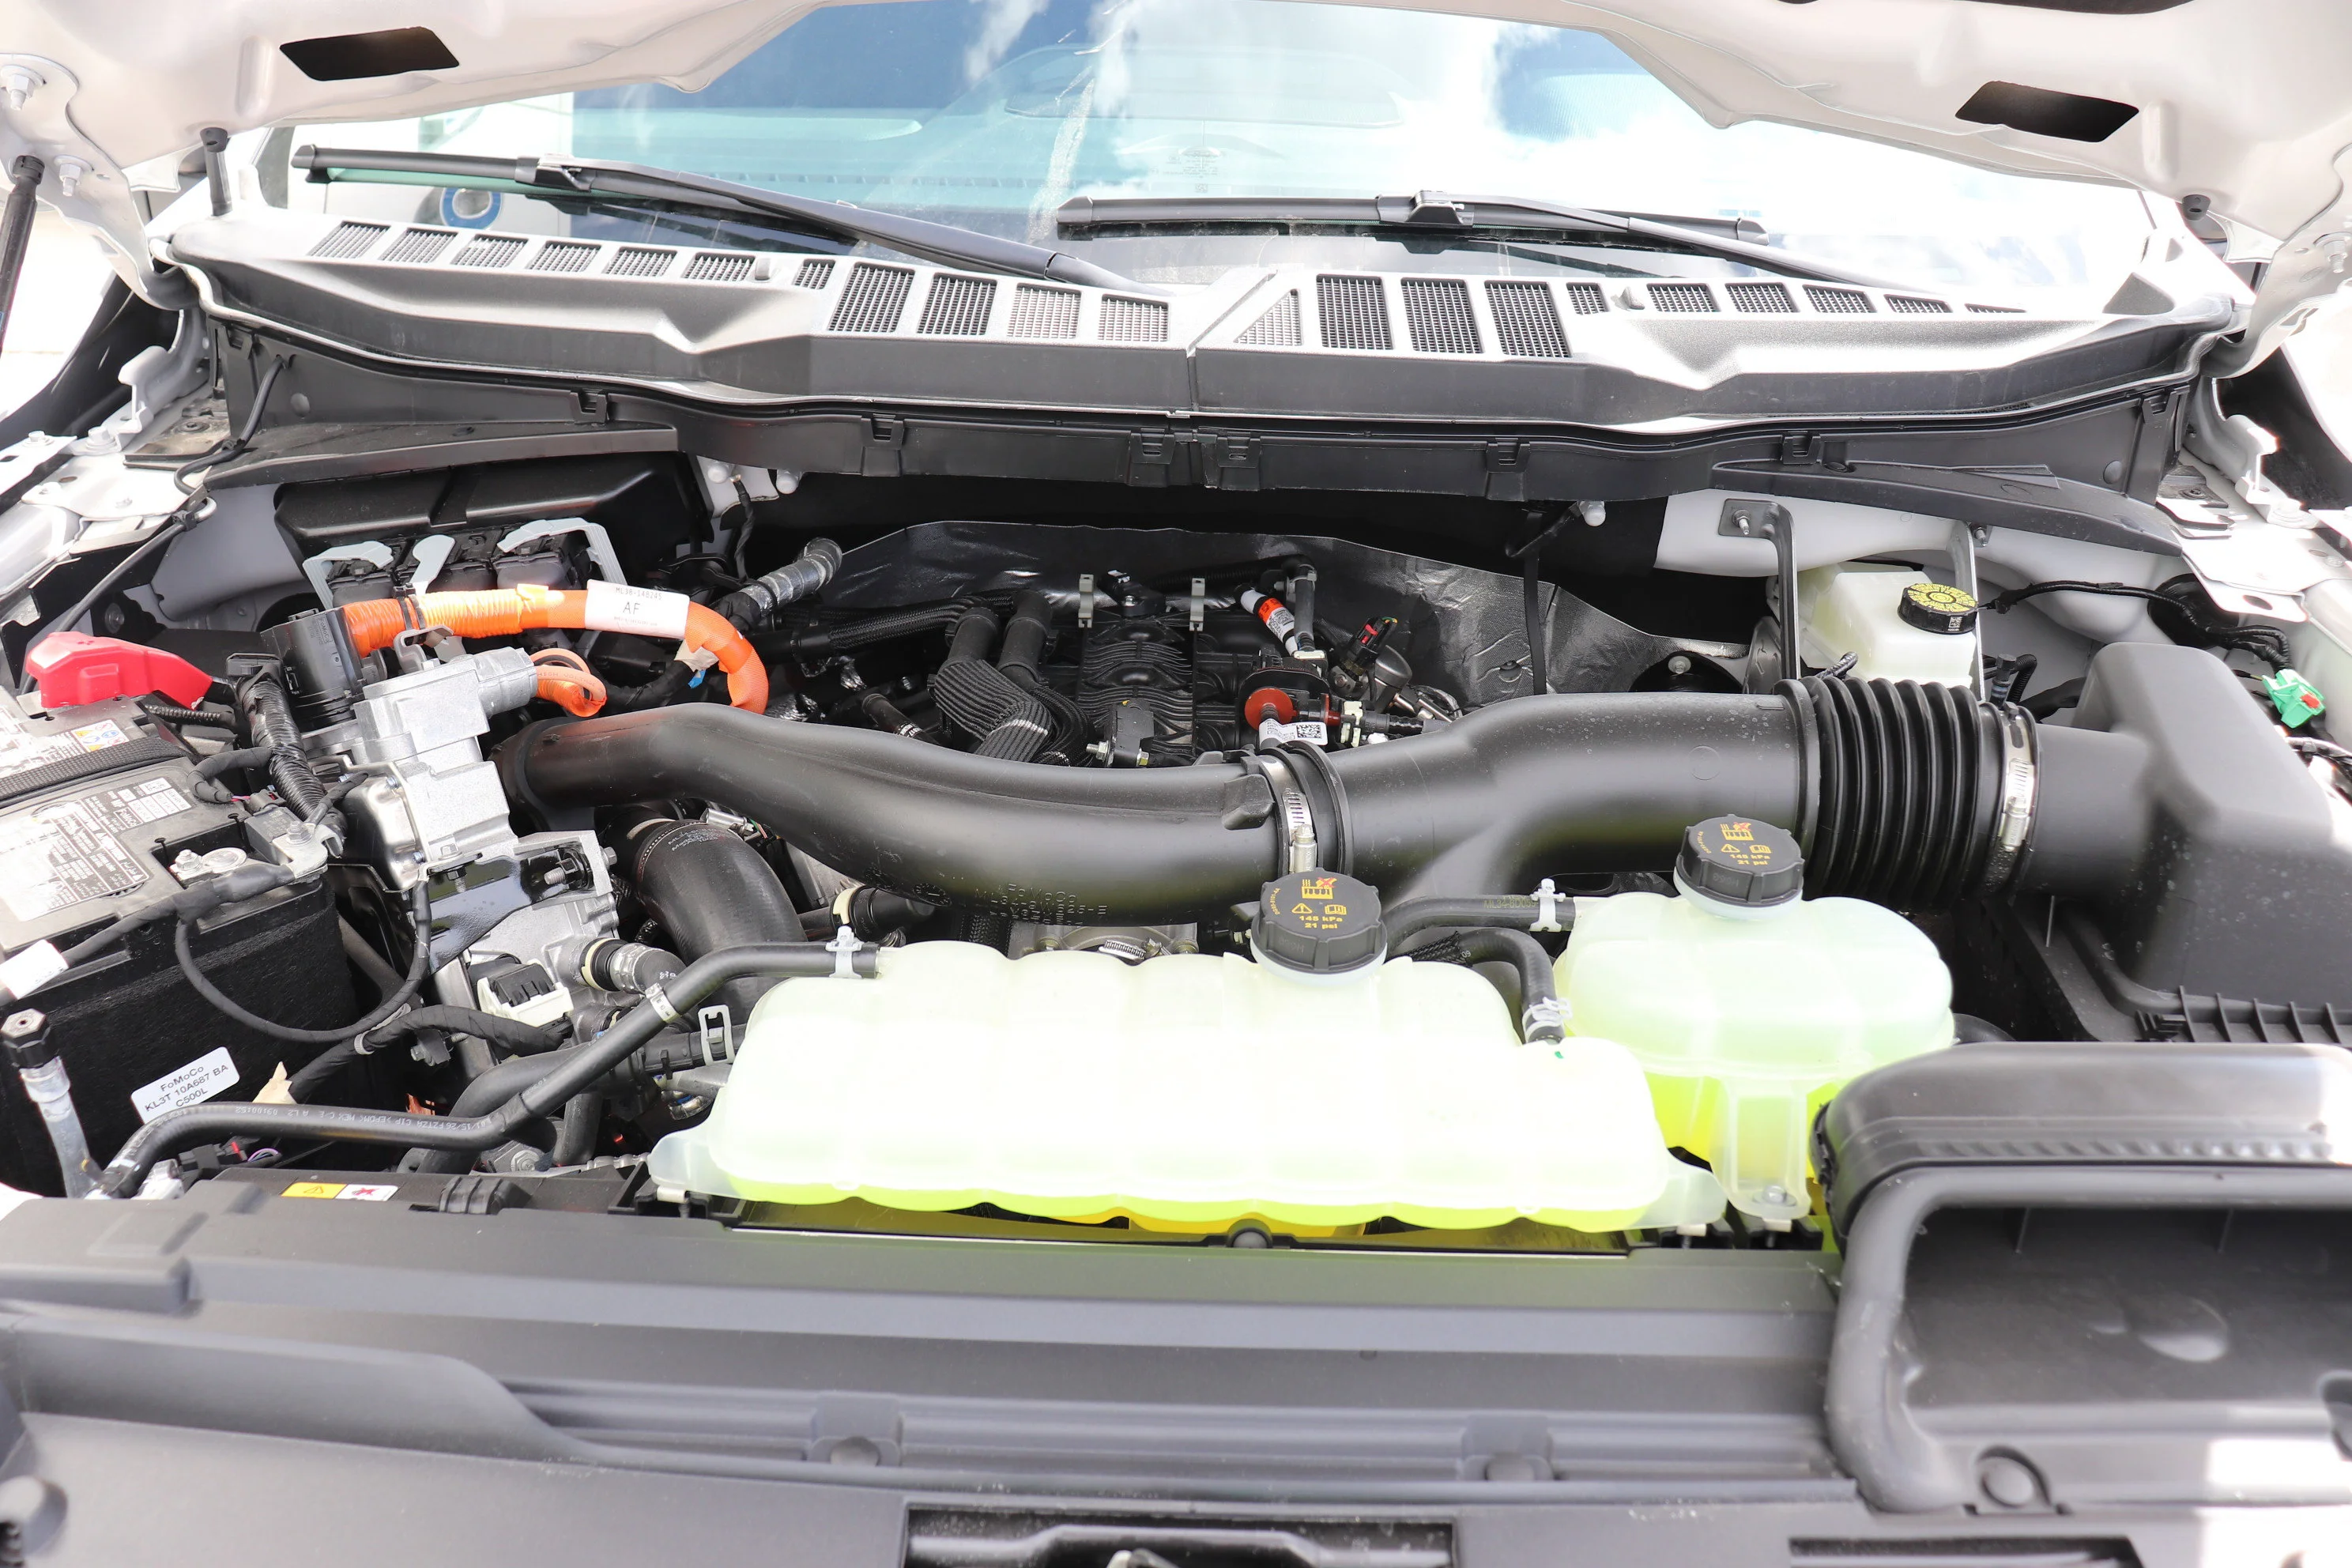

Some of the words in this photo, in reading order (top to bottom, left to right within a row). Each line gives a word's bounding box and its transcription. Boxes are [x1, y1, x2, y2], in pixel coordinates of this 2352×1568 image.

[623, 601, 641, 615] AF
[145, 1093, 172, 1112] KL3T
[175, 1072, 210, 1096] 10A687
[213, 1064, 229, 1076] BA
[160, 1066, 204, 1092] FoMoCo
[175, 1087, 209, 1107] C500L
